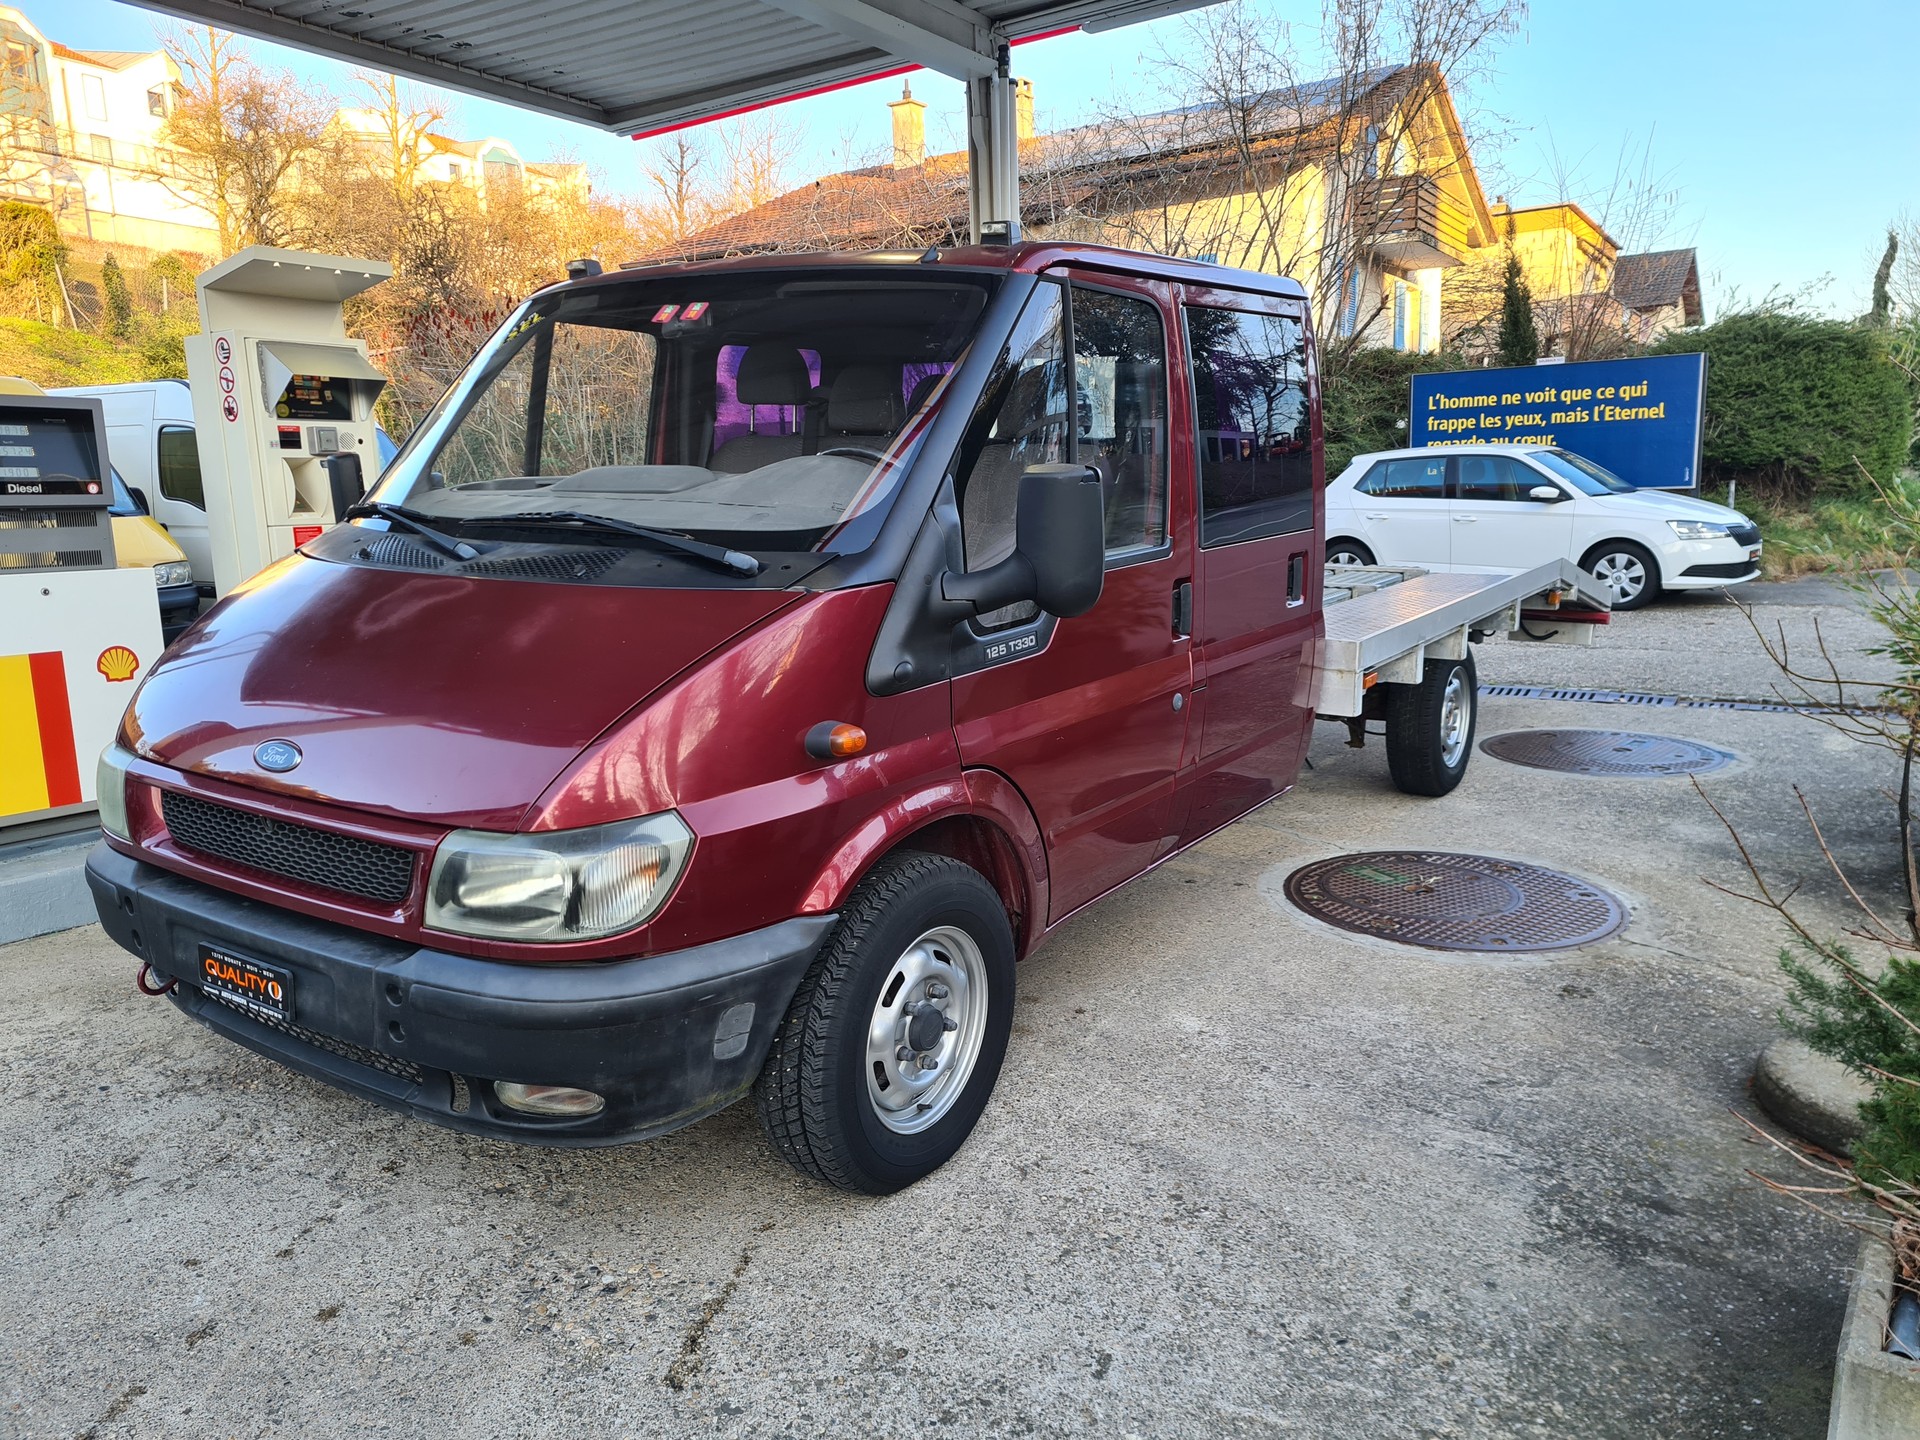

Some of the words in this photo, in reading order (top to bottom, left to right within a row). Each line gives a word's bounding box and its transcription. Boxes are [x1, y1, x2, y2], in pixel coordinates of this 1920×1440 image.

[1501, 393, 1521, 405] ne
[1525, 387, 1557, 403] voit
[1560, 388, 1592, 405] que
[1596, 386, 1615, 399] ce
[1619, 380, 1648, 401] qui
[1427, 416, 1476, 434] frappe
[1480, 413, 1502, 428] les
[1505, 413, 1546, 431] yeux,
[1551, 407, 1589, 424] mais
[7, 483, 42, 493] Diesel
[986, 644, 1007, 659] 125
[1009, 635, 1036, 651] T330
[262, 746, 288, 764] Ford
